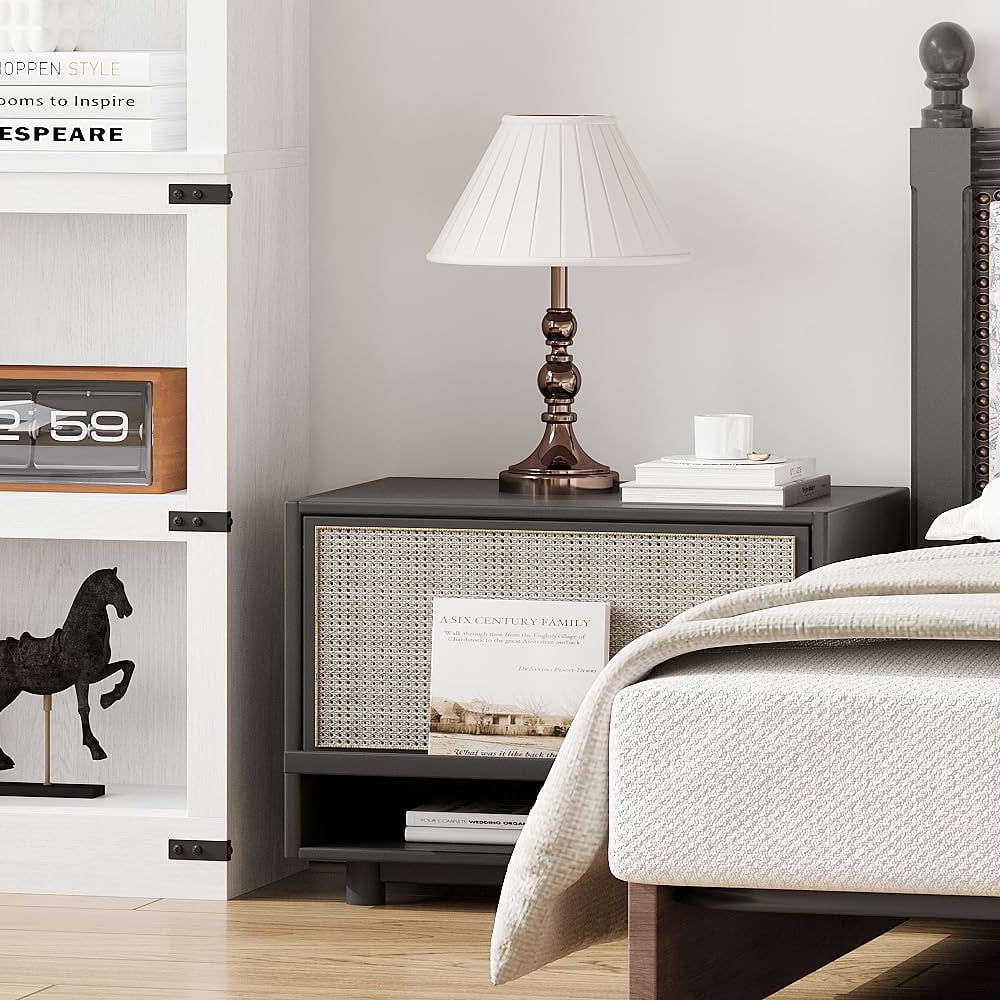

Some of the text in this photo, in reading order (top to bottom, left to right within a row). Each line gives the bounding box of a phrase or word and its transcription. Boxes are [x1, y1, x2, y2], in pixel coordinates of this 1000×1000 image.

[68, 61, 121, 76] STYLE
[51, 96, 68, 107] to
[74, 95, 135, 110] Inspire
[50, 410, 130, 442] 59
[440, 616, 591, 627] A SIX CENTURY FAMILY
